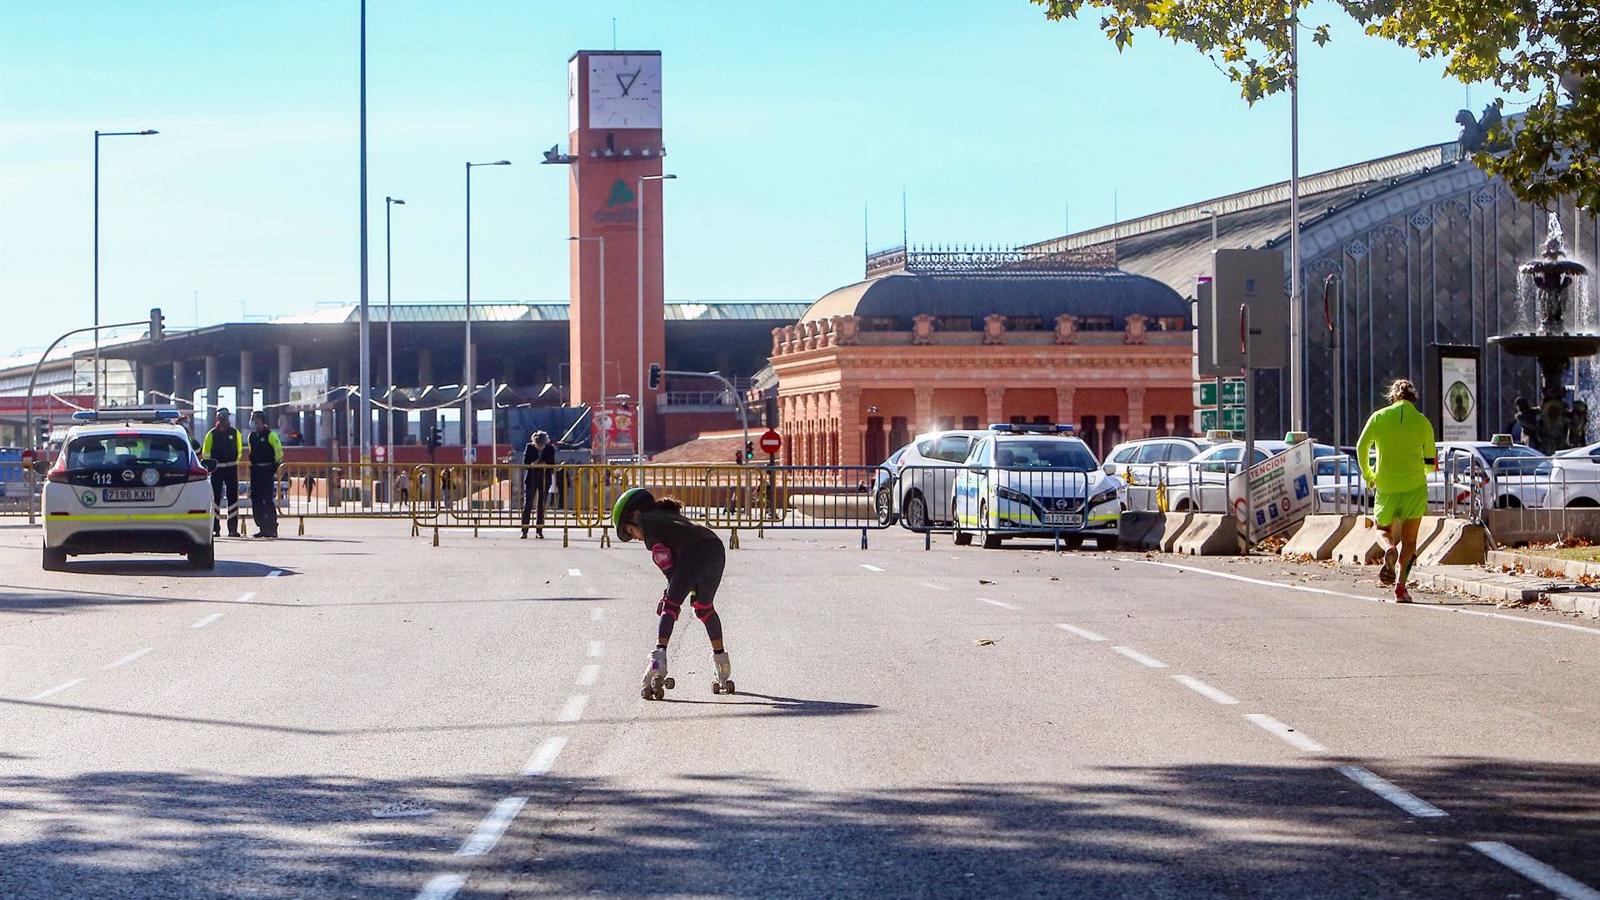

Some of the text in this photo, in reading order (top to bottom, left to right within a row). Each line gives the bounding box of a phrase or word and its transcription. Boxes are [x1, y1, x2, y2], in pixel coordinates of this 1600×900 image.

[1249, 455, 1286, 480] TENCION
[96, 473, 112, 484] 112
[108, 490, 153, 499] 7196 KXH
